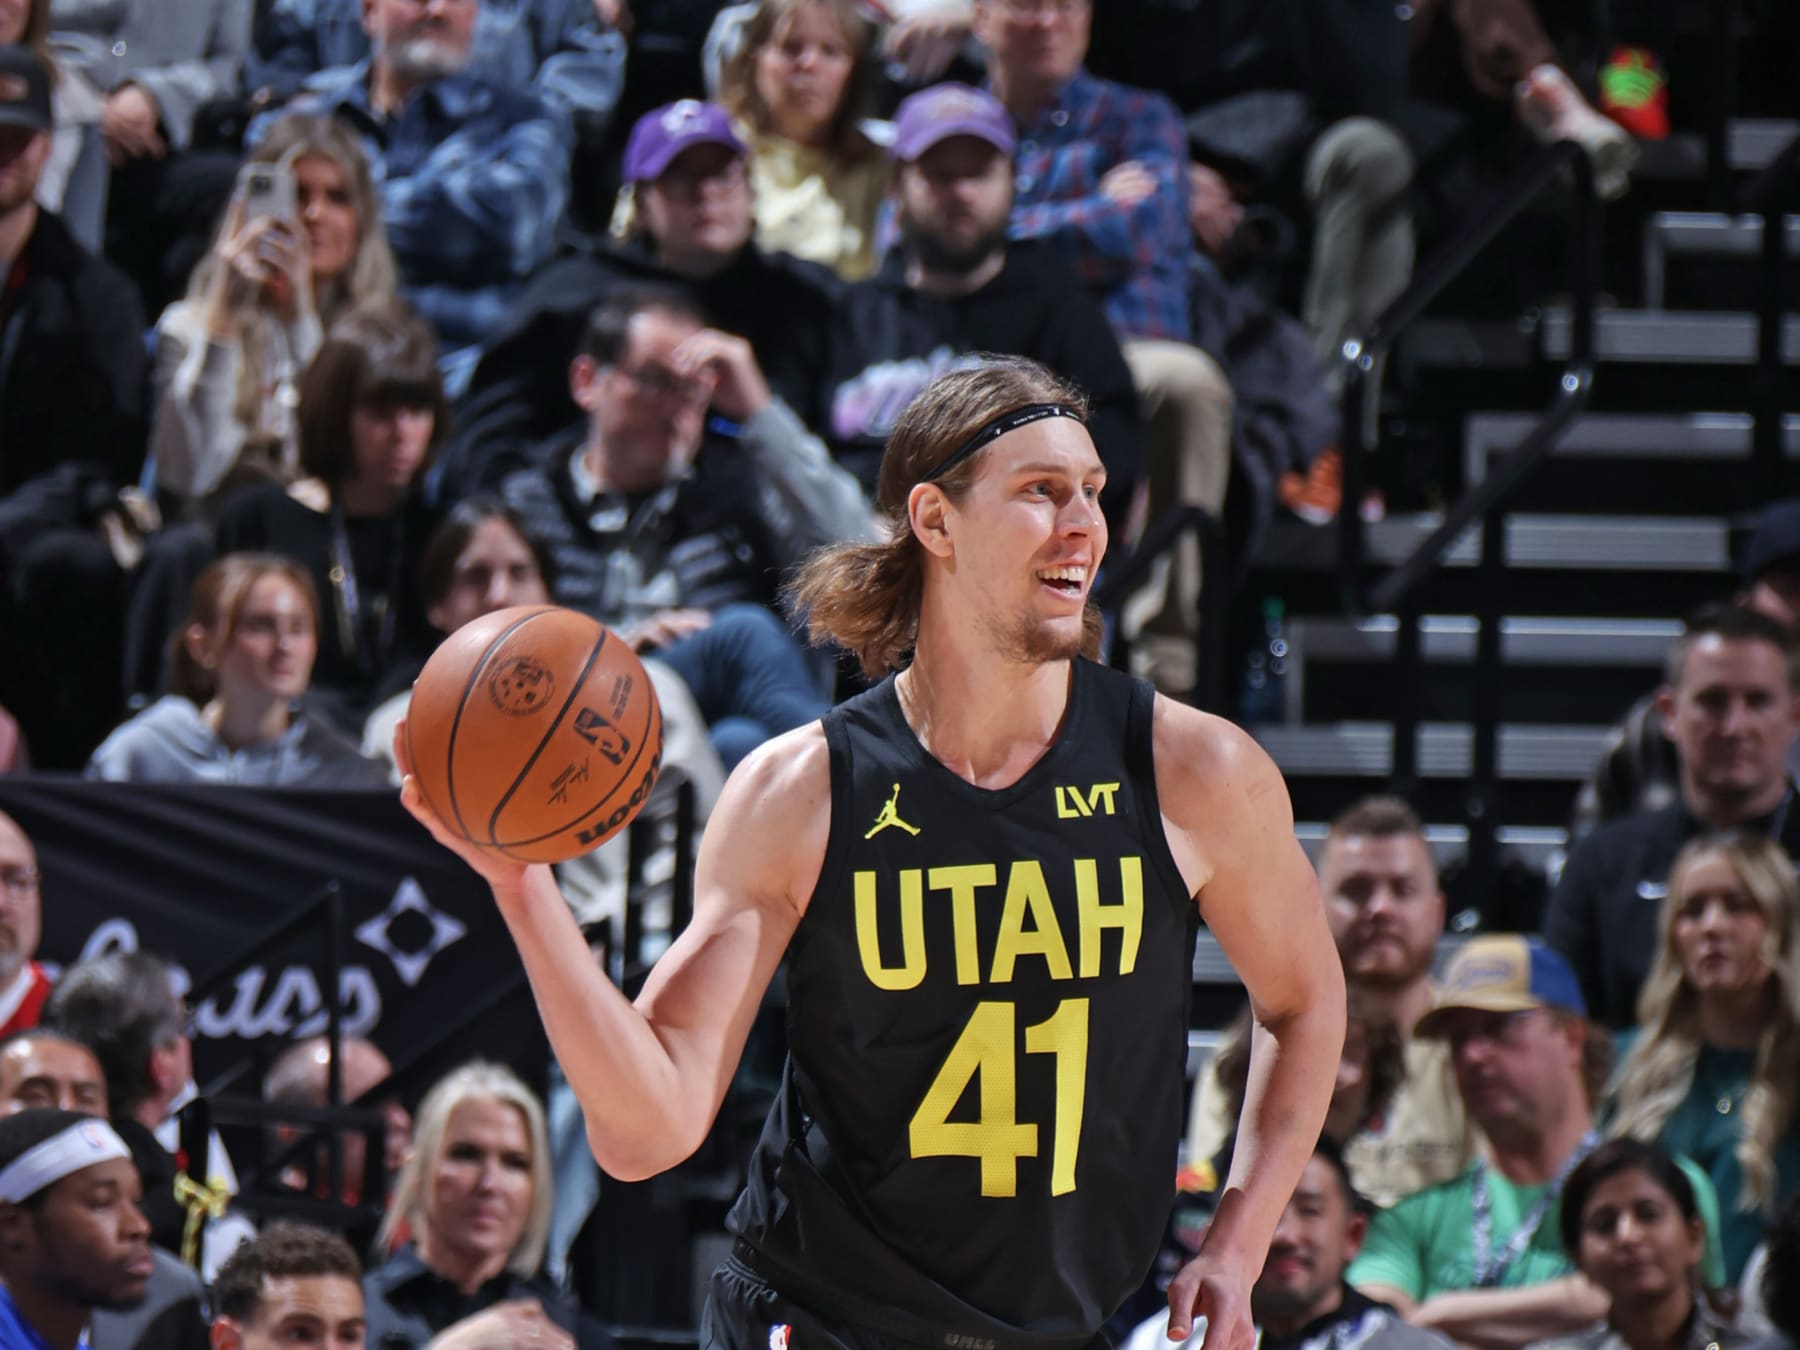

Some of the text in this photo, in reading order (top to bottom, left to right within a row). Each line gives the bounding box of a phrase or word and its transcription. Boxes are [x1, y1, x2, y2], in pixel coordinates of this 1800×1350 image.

[1055, 782, 1120, 818] LVT
[853, 857, 1144, 990] UTAH
[909, 998, 1090, 1197] 41
